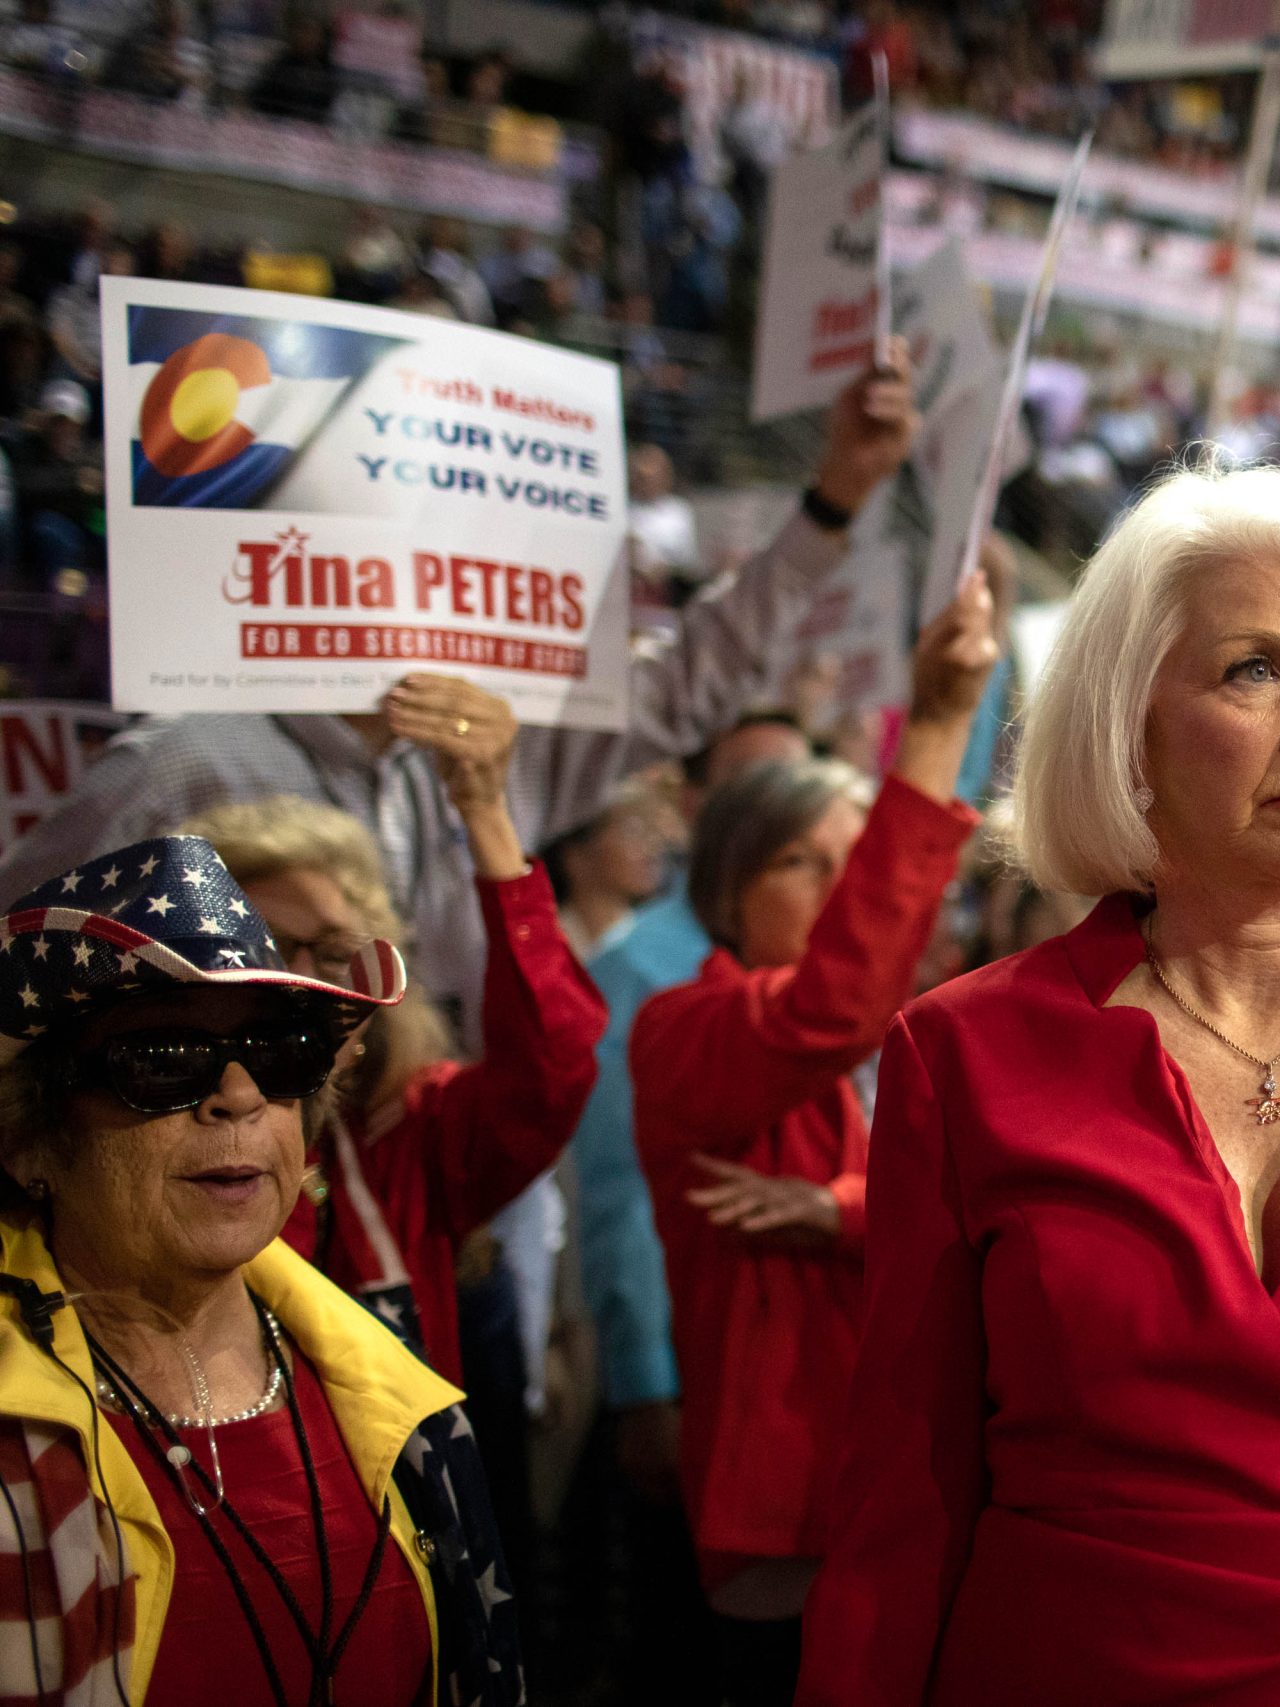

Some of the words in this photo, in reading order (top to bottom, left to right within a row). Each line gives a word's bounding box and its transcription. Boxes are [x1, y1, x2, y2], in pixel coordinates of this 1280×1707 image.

[396, 368, 484, 406] Truth
[491, 386, 597, 433] Matters
[364, 407, 492, 452] YOUR
[501, 431, 599, 476] VOTE
[356, 453, 488, 496] YOUR
[495, 473, 610, 521] VOICE
[230, 530, 396, 608] Tina
[411, 550, 584, 632] PETERS
[245, 625, 299, 657] FOR
[314, 627, 351, 657] CO
